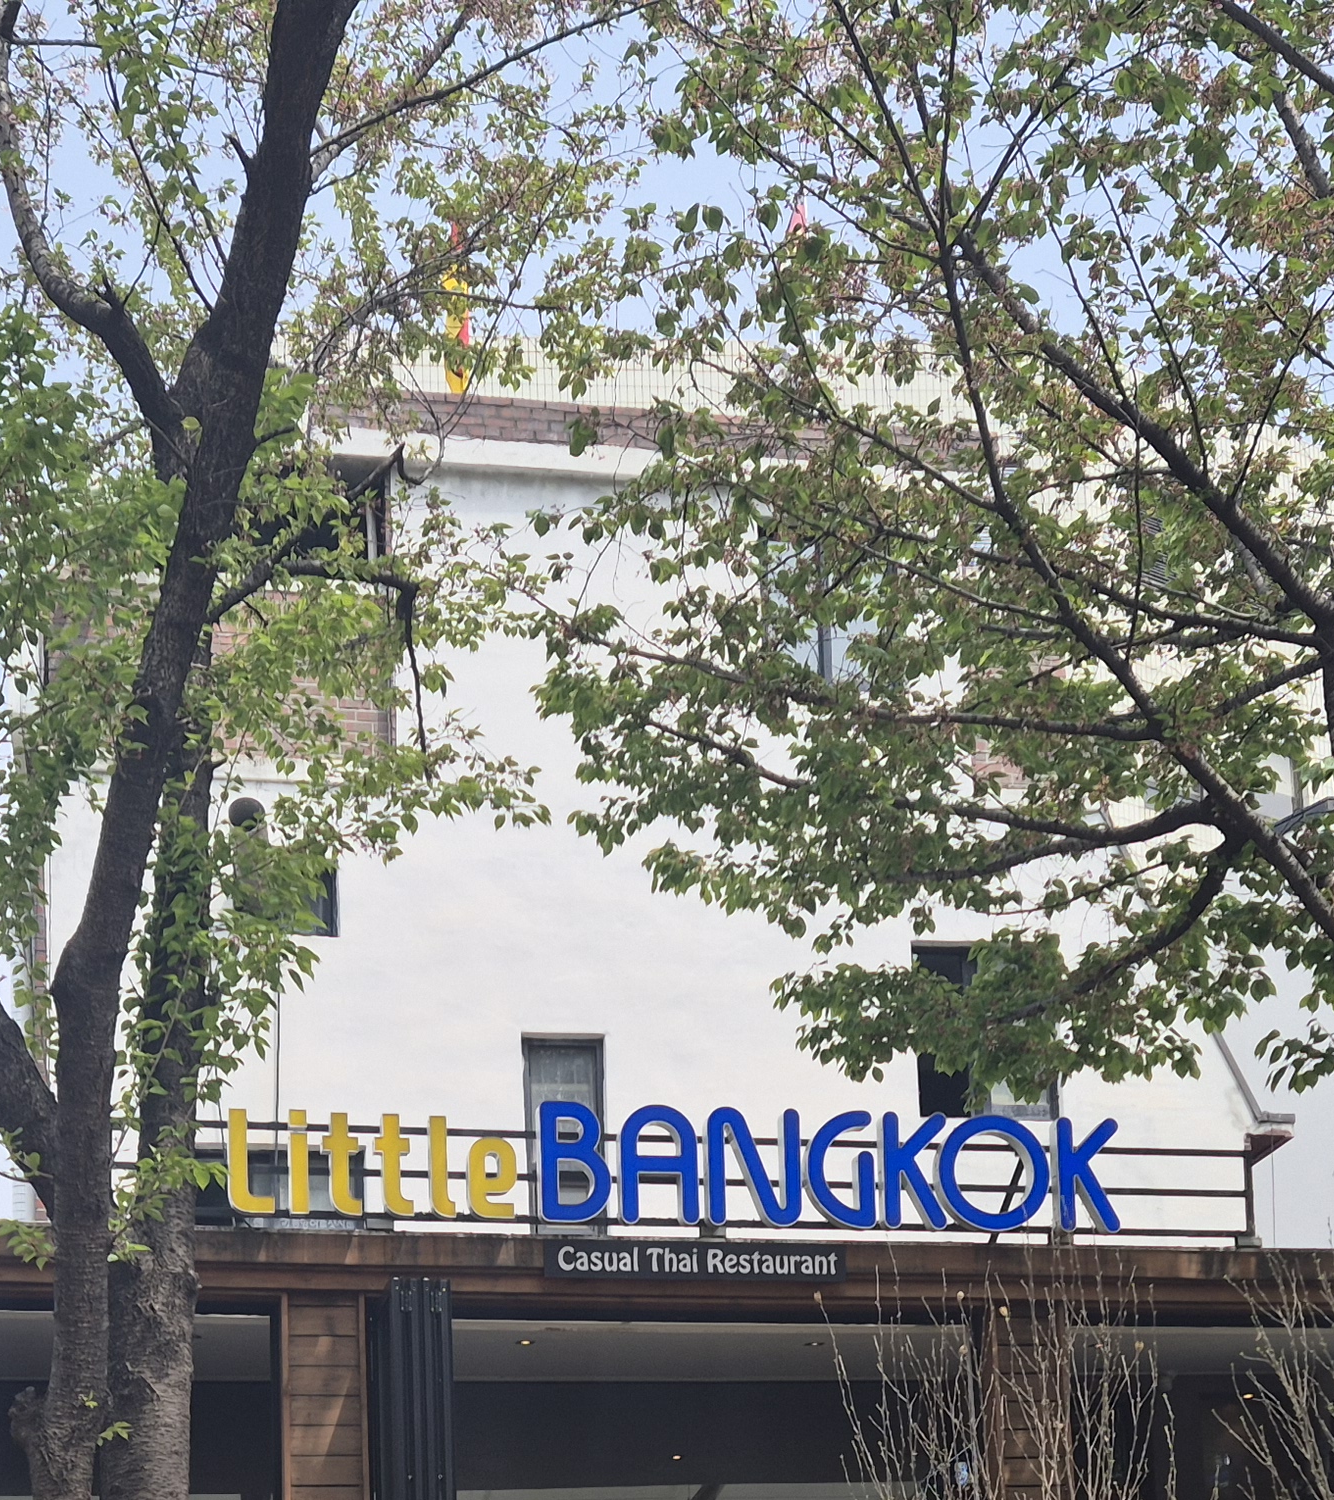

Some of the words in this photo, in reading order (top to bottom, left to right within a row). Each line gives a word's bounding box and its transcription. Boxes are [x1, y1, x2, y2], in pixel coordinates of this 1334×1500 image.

[226, 1108, 517, 1219] Little
[536, 1101, 1121, 1234] BANGKOK
[557, 1245, 639, 1273] Casual
[646, 1248, 698, 1273] Thai
[707, 1249, 838, 1276] Restaurant
